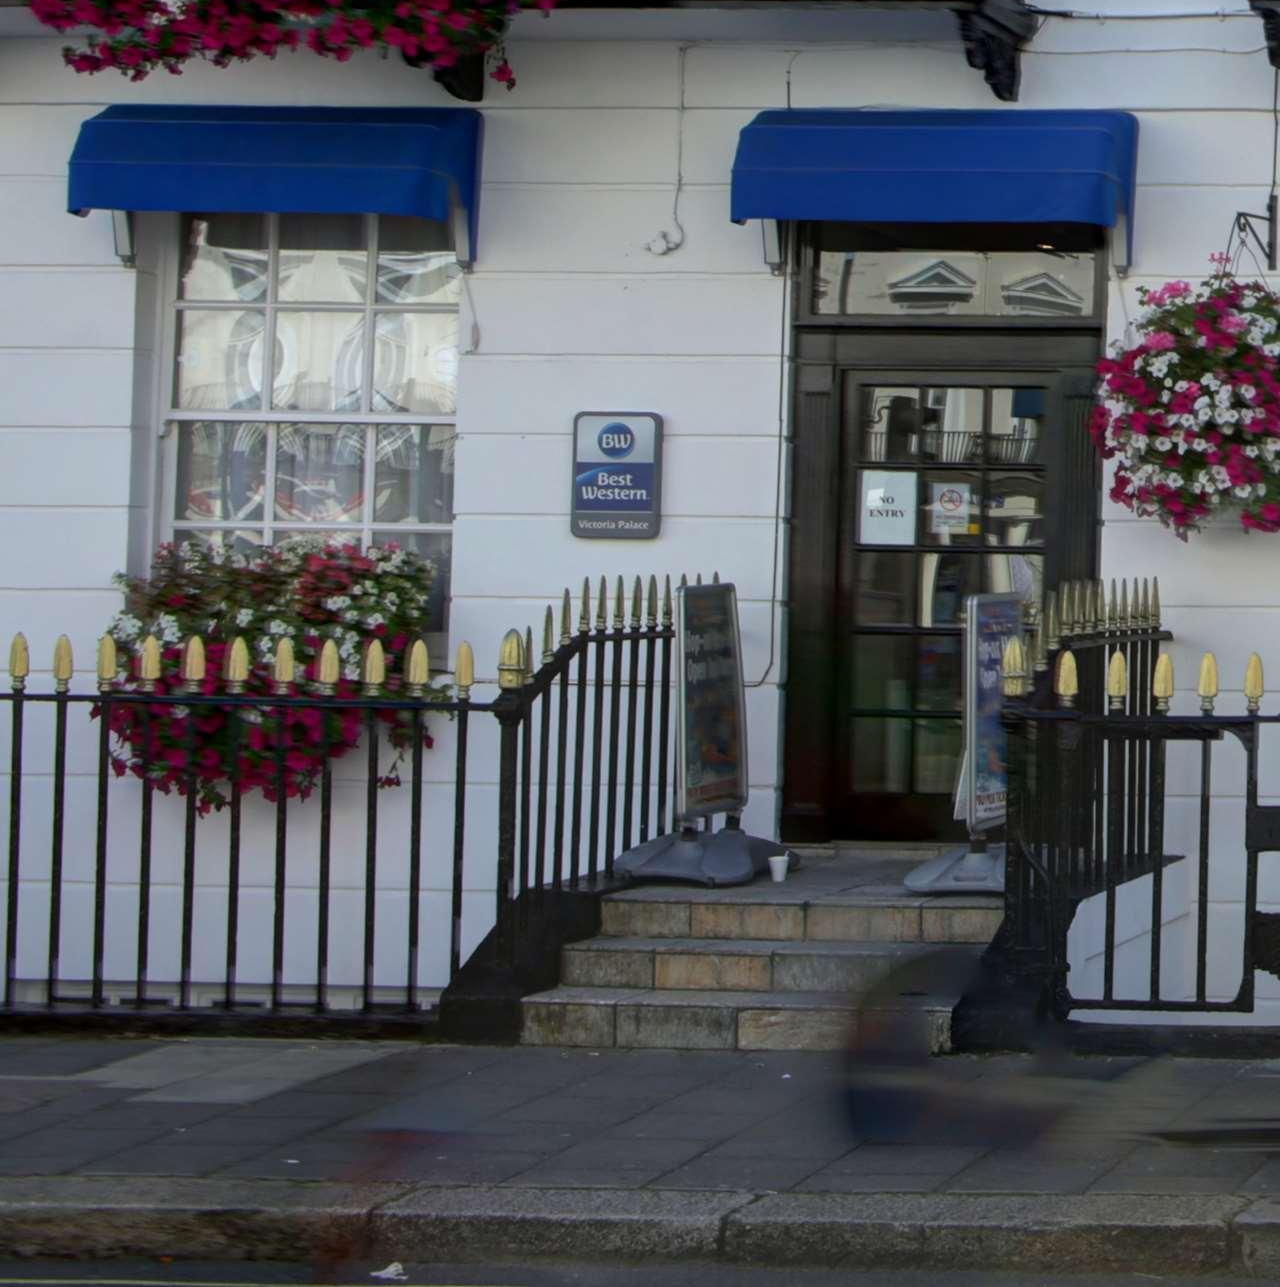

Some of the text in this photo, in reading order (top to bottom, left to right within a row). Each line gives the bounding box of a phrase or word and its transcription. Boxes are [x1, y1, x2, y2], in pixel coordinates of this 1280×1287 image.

[601, 433, 631, 449] BW
[597, 472, 633, 486] Best
[581, 486, 647, 500] Western
[879, 494, 895, 505] NO
[868, 508, 906, 518] ENTRY
[578, 519, 649, 529] Victoria Palace
